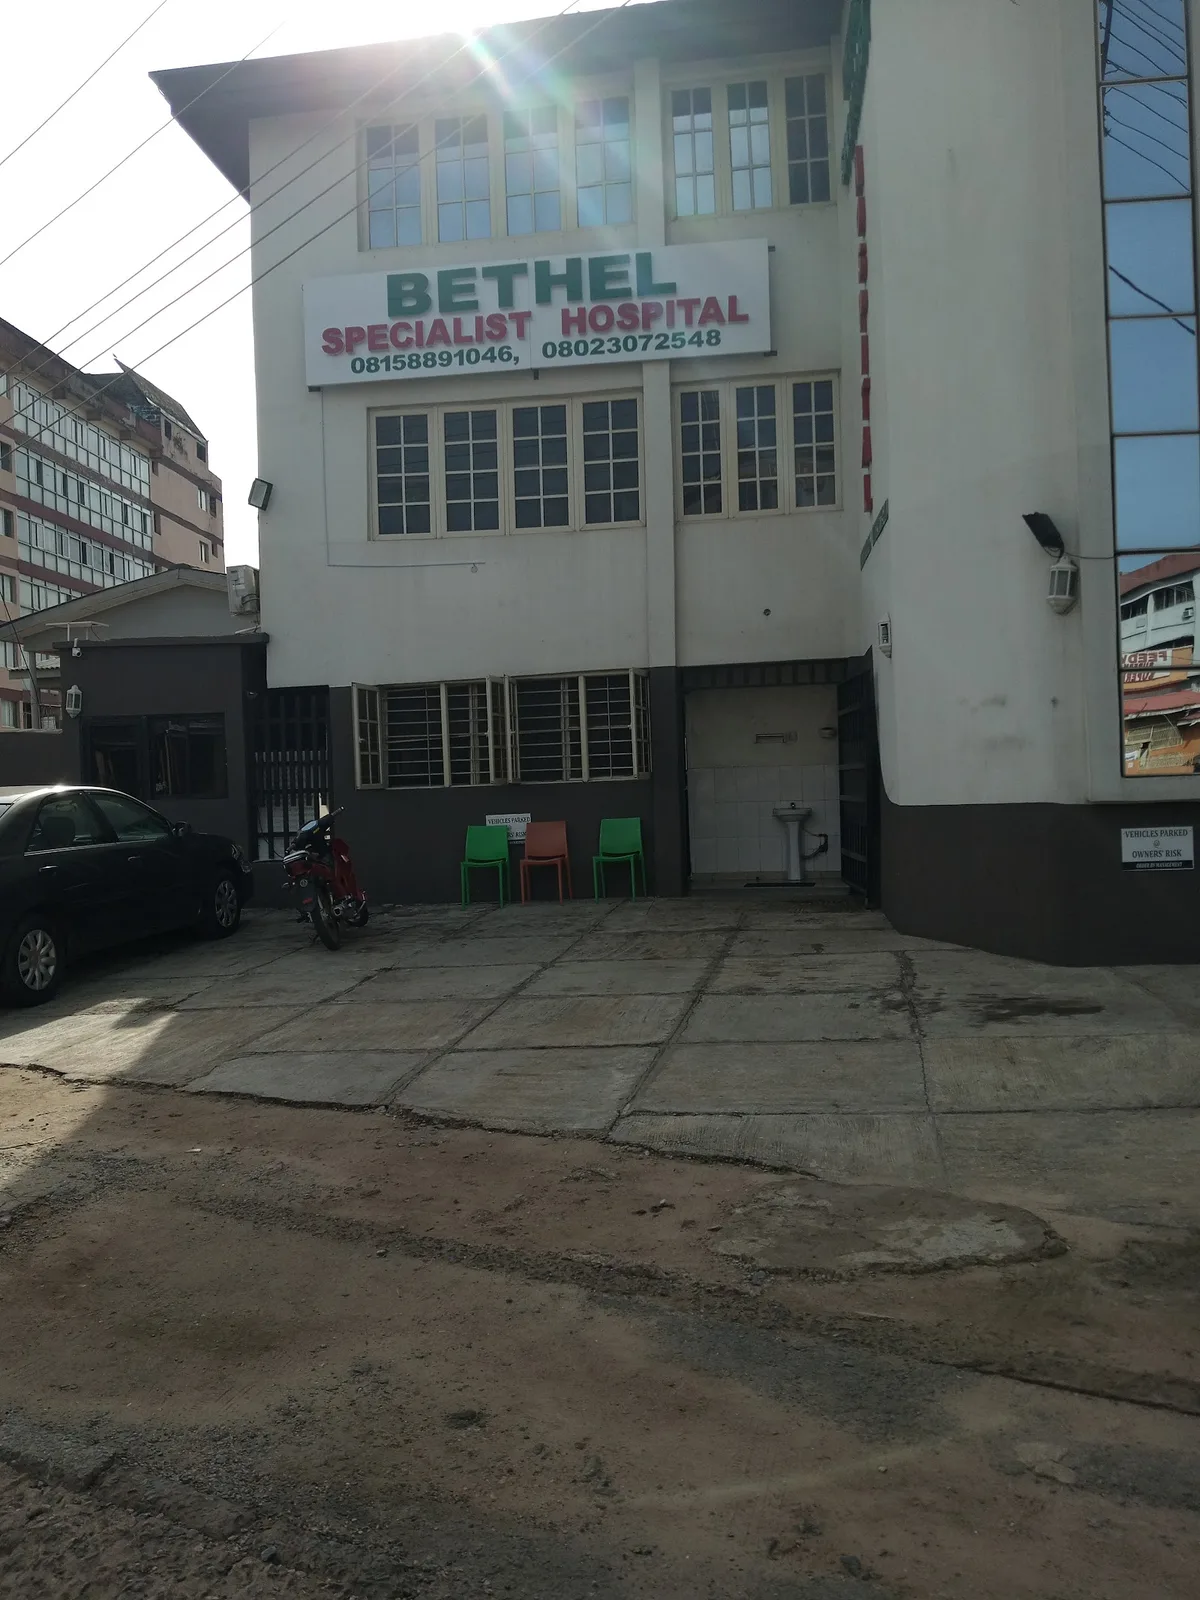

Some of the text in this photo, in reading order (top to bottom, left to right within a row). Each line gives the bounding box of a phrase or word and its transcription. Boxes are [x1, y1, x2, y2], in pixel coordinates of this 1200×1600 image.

[386, 251, 677, 319] BETHEL
[321, 295, 750, 356] SPECIALIST HOSPITAL
[350, 329, 722, 375] 08158891046, 08023072548
[1125, 828, 1188, 838] VEHICLES PARKED
[1153, 840, 1160, 848] @
[1132, 849, 1182, 859] OWNERS' RISK
